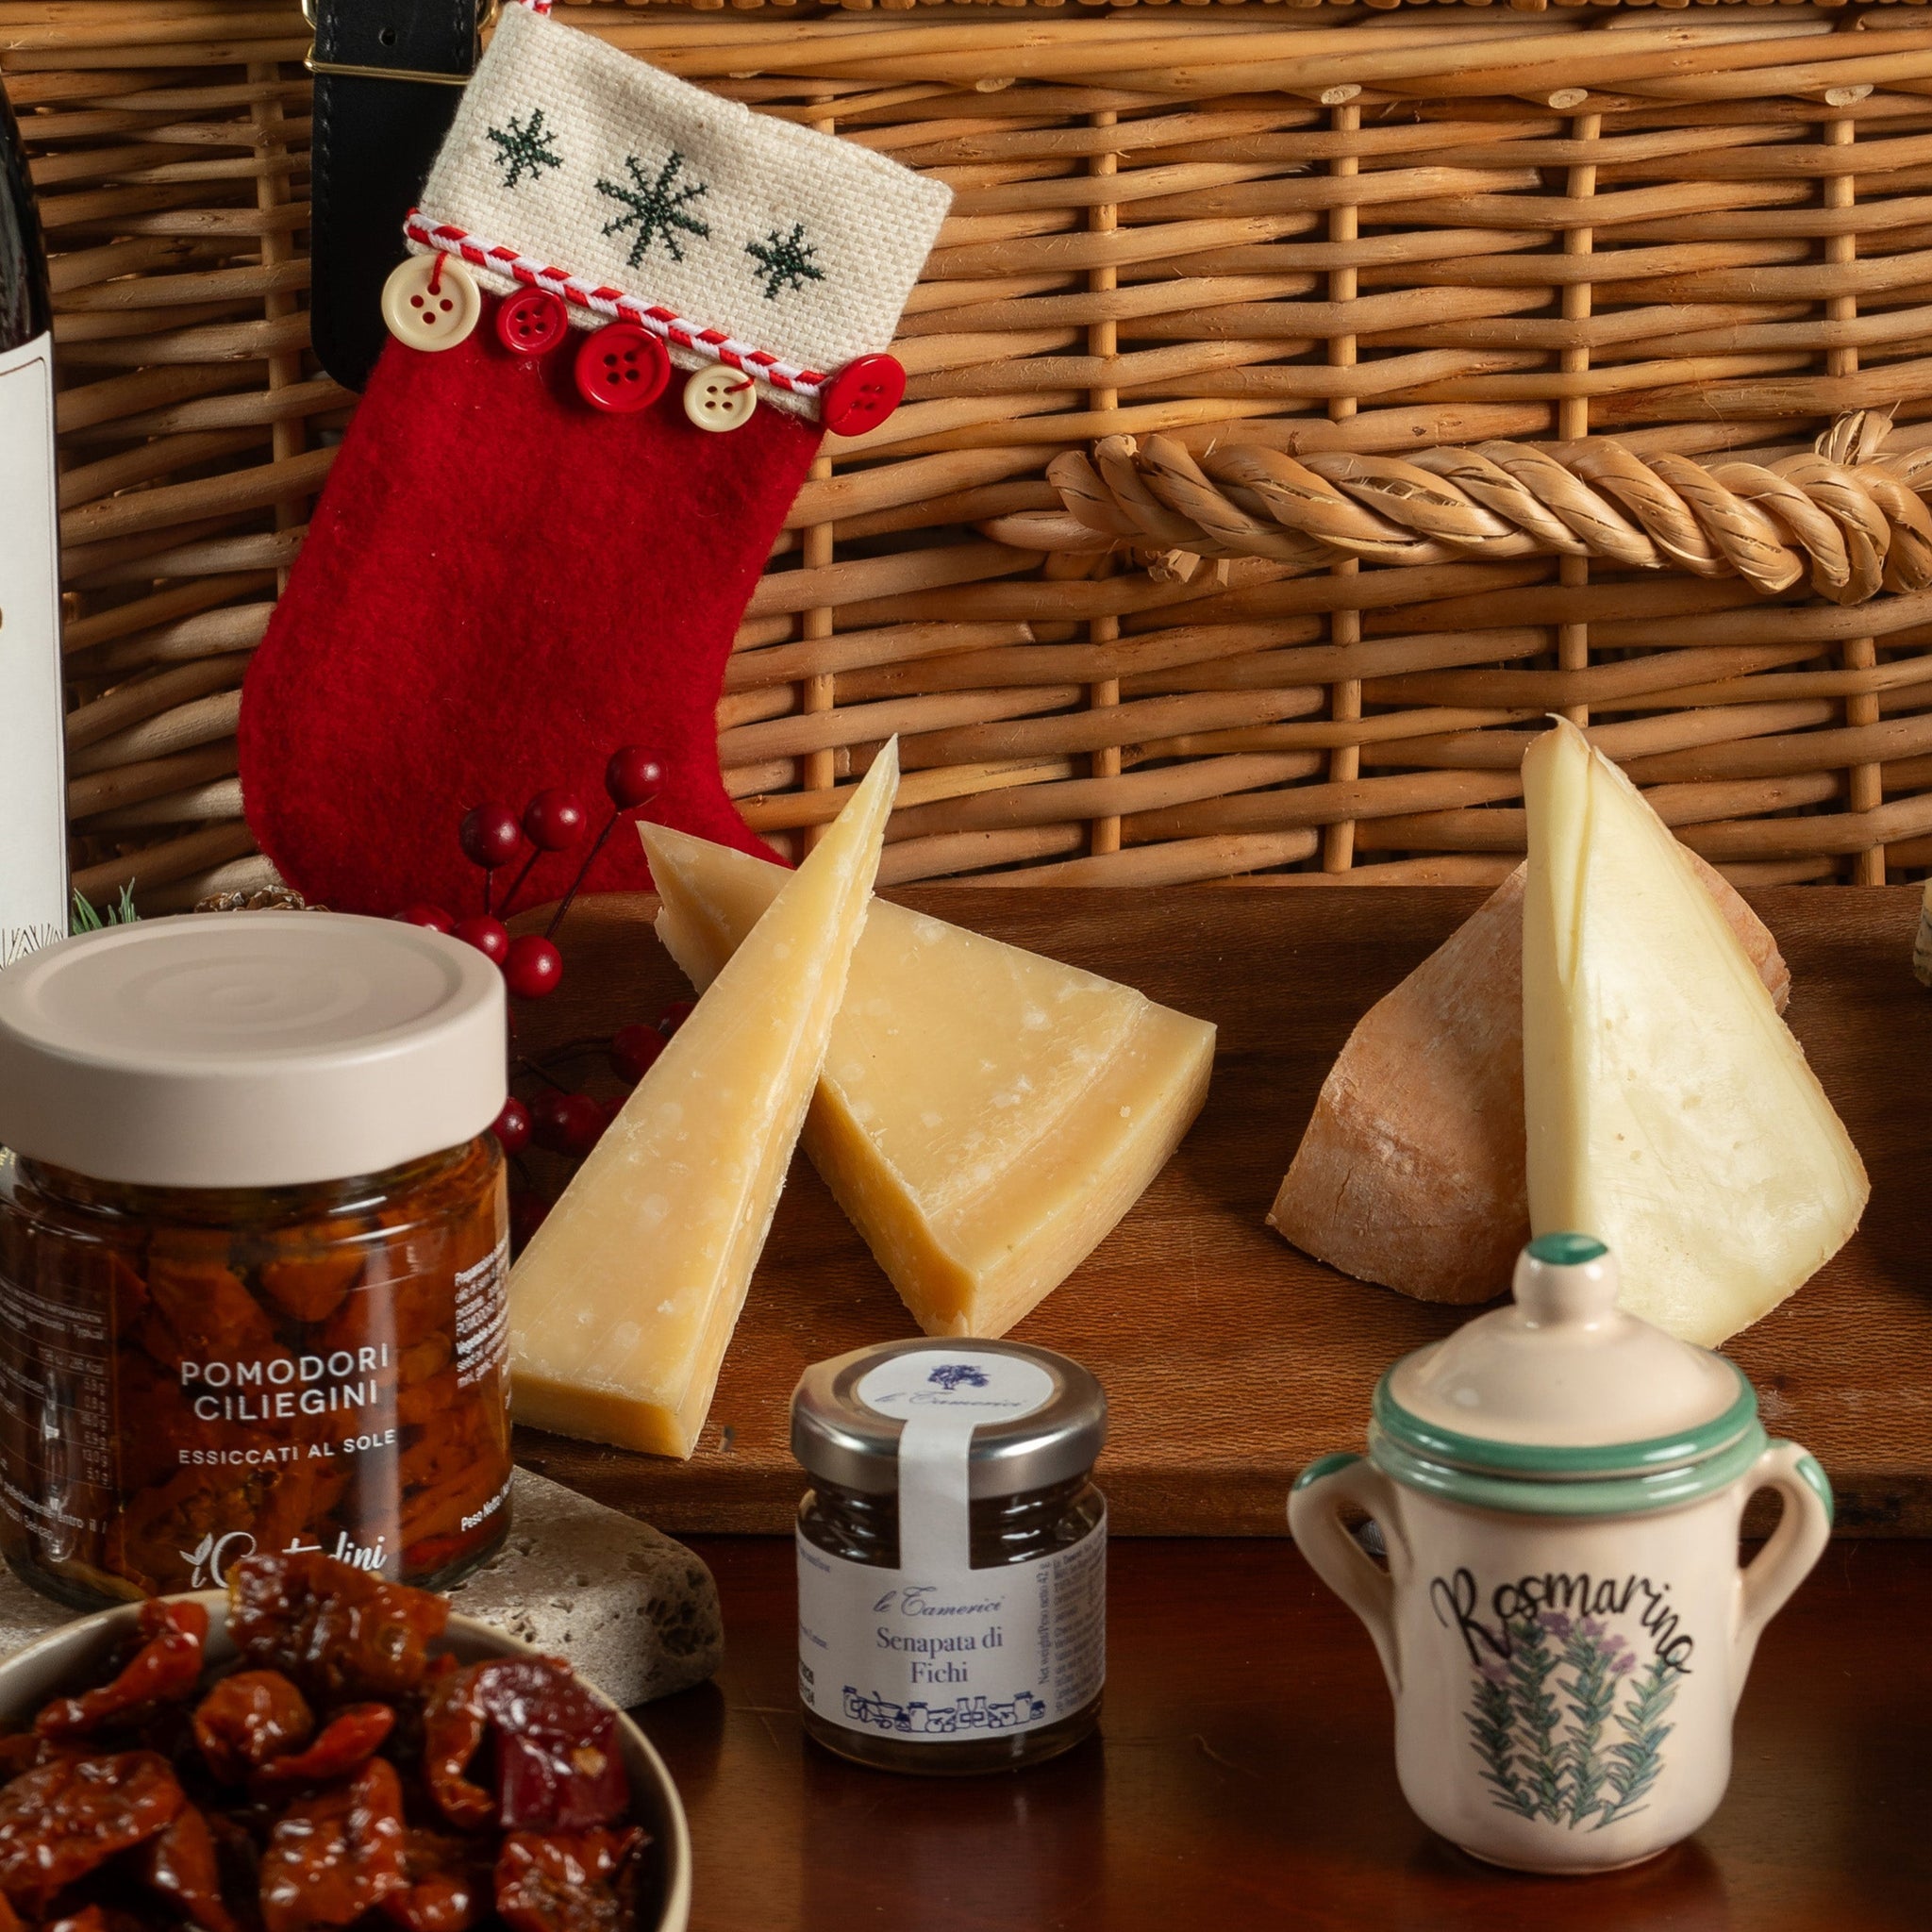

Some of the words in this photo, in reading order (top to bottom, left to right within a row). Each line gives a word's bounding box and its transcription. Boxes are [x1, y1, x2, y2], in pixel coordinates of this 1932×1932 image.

[181, 1342, 388, 1387] POMODORI
[194, 1379, 377, 1421] CILIEGINI
[178, 1446, 299, 1465] ESSICCATI
[308, 1442, 335, 1458] AL
[342, 1428, 396, 1453] SOLE
[874, 1591, 897, 1612] le
[900, 1586, 1007, 1617] Tamerici
[1429, 1567, 1696, 1674] Rosmarino
[876, 1626, 976, 1659] Senapata
[981, 1625, 1003, 1648] di
[910, 1661, 969, 1683] Fichi
